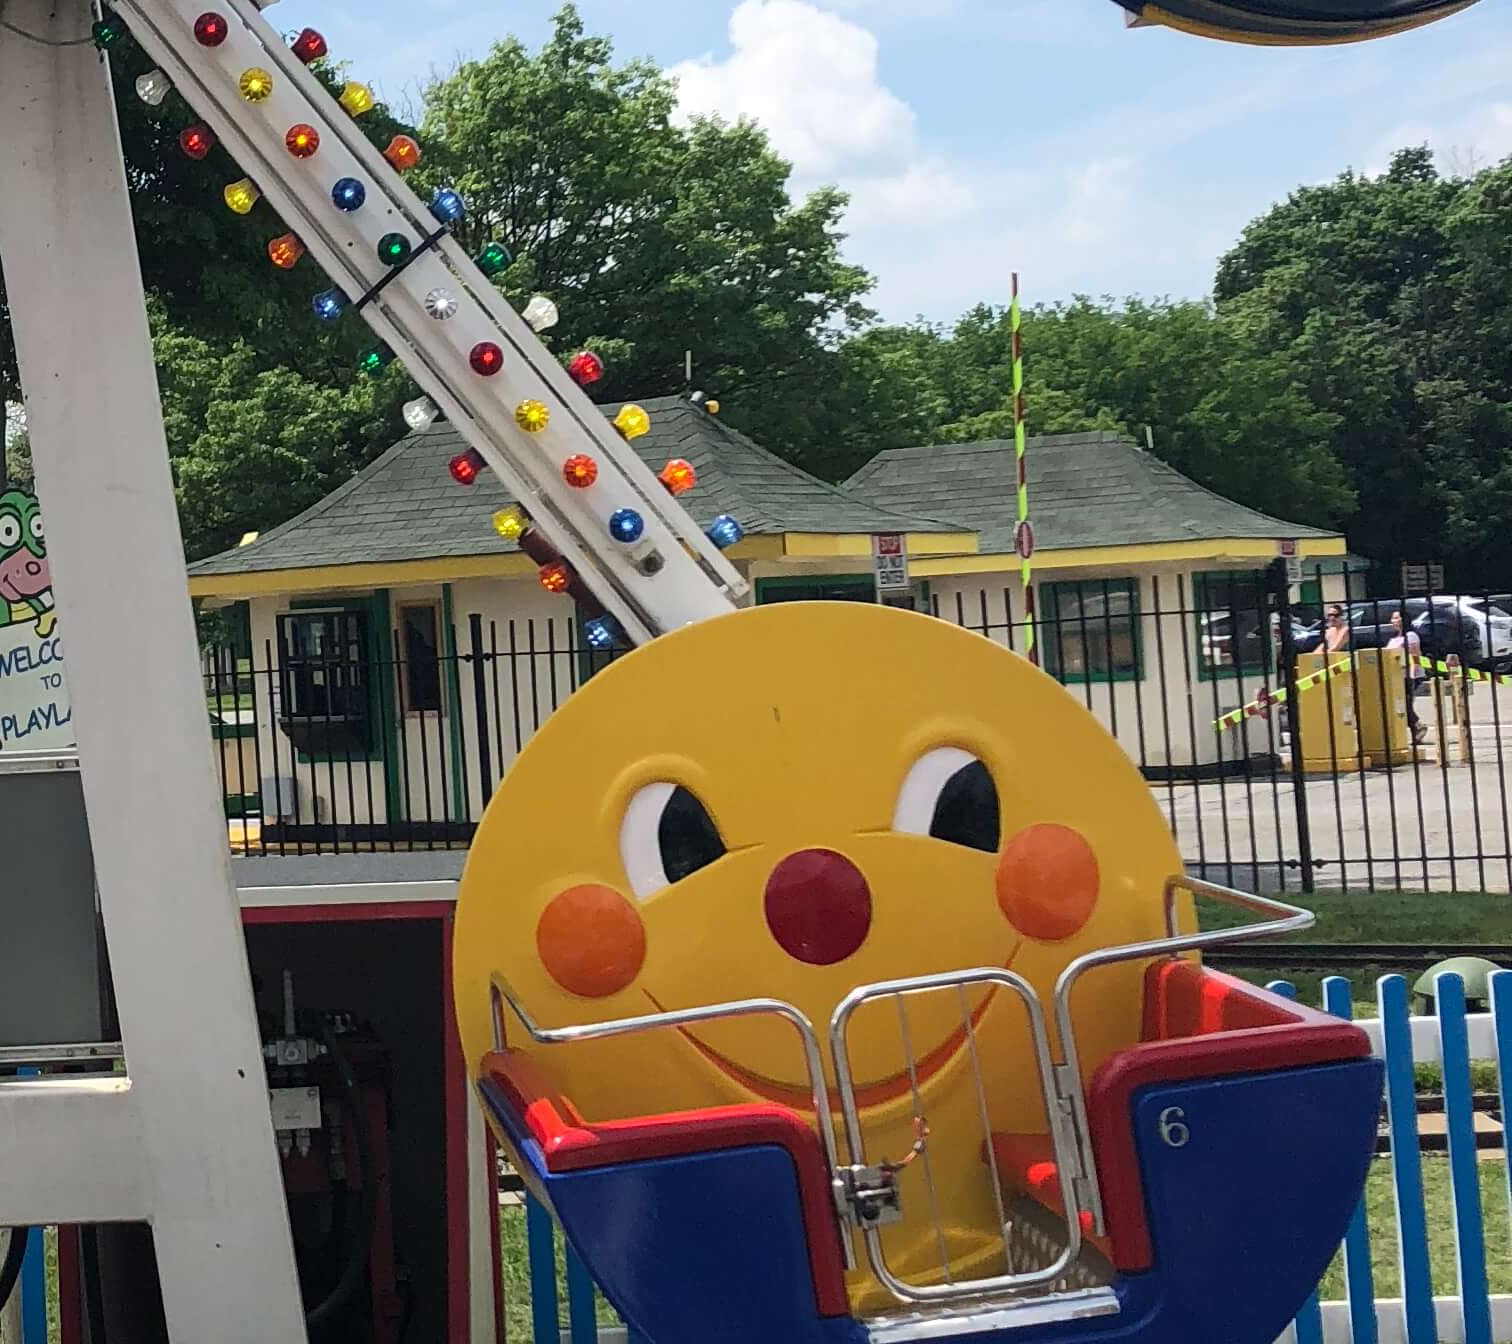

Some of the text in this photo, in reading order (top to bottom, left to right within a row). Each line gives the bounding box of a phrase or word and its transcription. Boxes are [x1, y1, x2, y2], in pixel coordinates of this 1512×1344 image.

[40, 672, 62, 690] TO
[1, 702, 72, 741] PLAYL
[1159, 1106, 1190, 1147] 6
